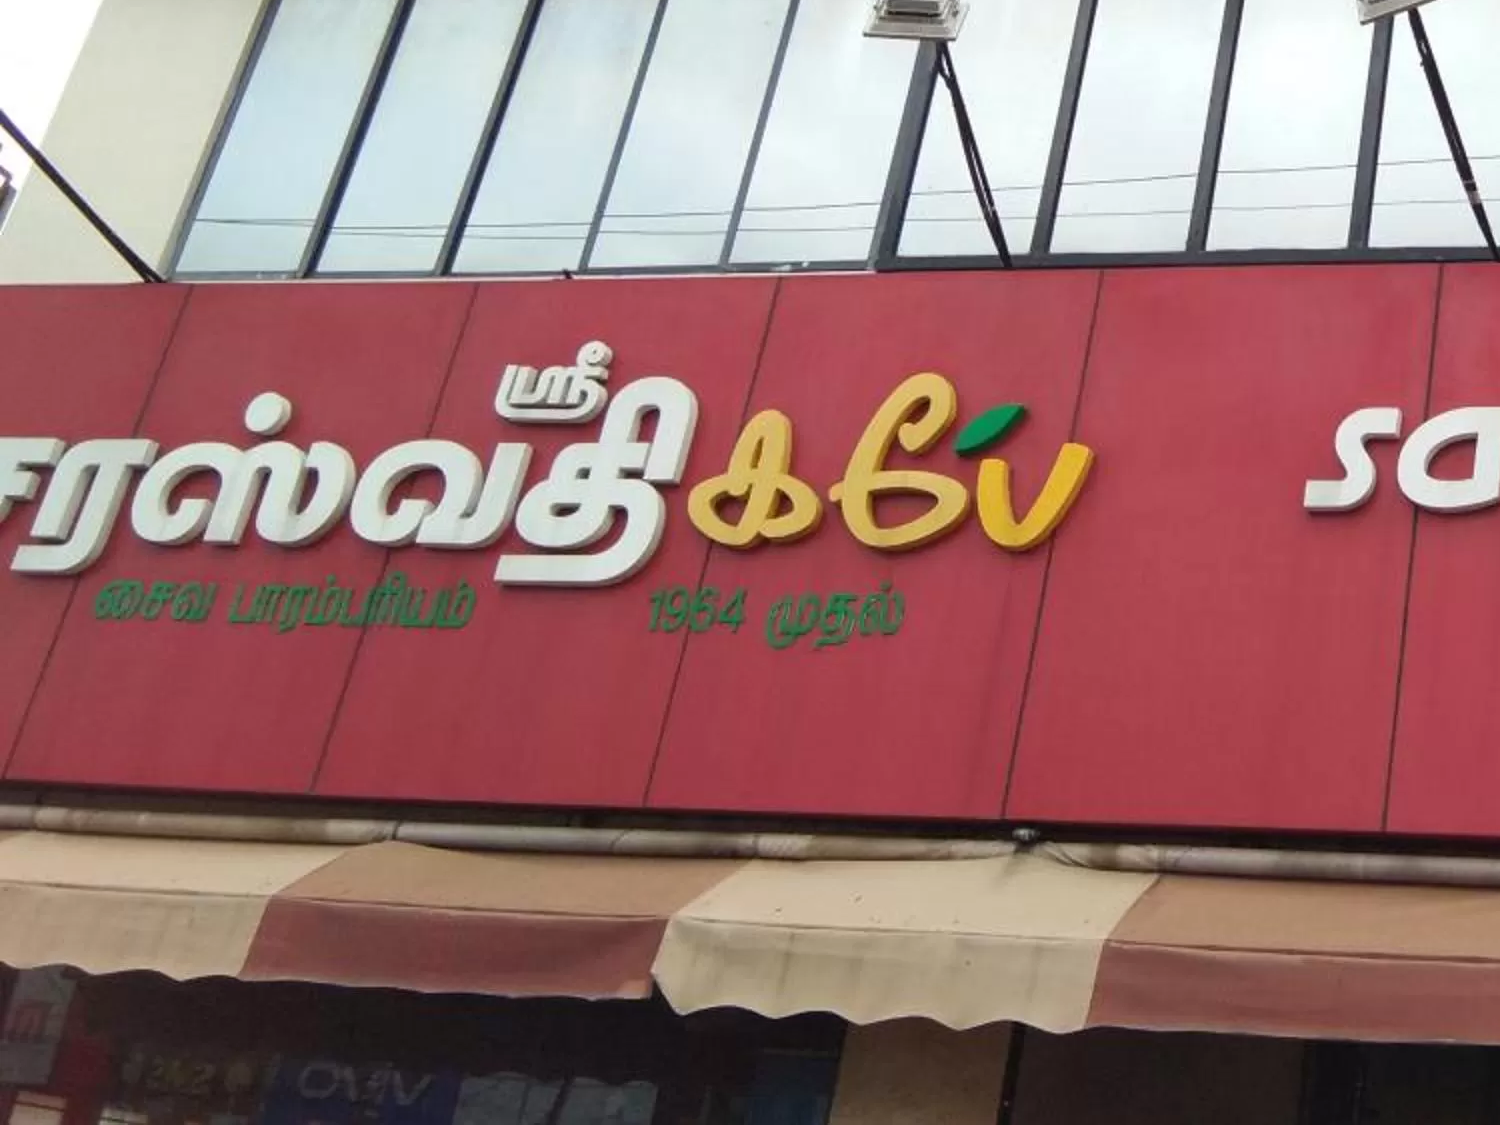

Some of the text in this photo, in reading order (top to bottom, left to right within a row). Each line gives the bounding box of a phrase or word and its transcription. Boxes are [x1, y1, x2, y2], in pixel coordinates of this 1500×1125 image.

[95, 579, 219, 622] சைவ
[648, 586, 749, 634] 1964
[764, 581, 906, 650] முதல்
